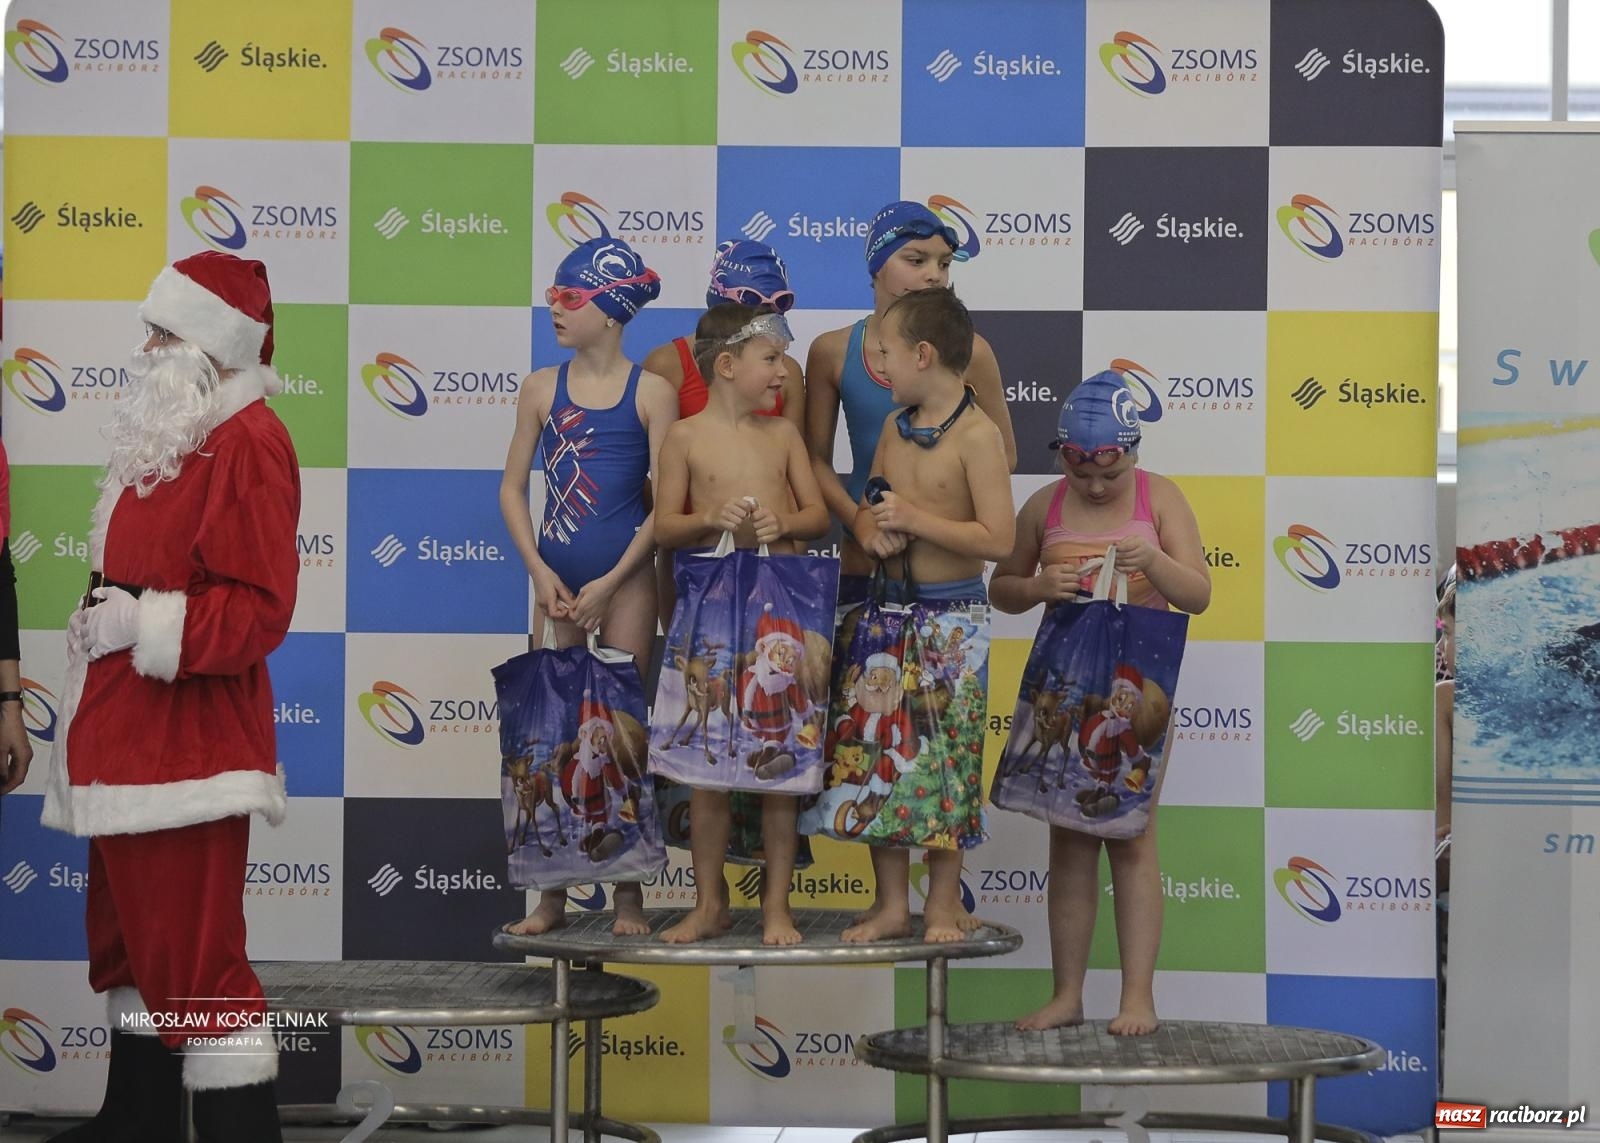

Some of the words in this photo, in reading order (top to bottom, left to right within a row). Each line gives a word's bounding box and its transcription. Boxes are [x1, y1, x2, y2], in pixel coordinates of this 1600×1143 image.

[74, 38, 160, 60] ZSOMS
[240, 42, 328, 73] Śląskie.
[437, 46, 523, 68] ZSOMS
[803, 49, 889, 71] ZSOMS
[1171, 49, 1257, 70] ZSOMS
[74, 63, 161, 73] RACIBÓRZ
[606, 48, 694, 78] Śląskie.
[973, 50, 1061, 81] Śląskie.
[1342, 49, 1430, 79] Śląskie.
[436, 70, 523, 80] RACIBÓRZ
[803, 73, 889, 83] RACIBÓRZ
[1171, 72, 1257, 82] RACIBÓRZ
[57, 203, 143, 233] Śląskie.
[251, 205, 337, 227] ZSOMS
[421, 208, 508, 239] Śląskie.
[618, 210, 704, 232] ZSOMS
[788, 211, 868, 242] Śląskie
[985, 213, 1072, 234] ZSOMS
[1348, 213, 1434, 234] ZSOMS
[251, 230, 337, 240] RACIBÓRZ
[1156, 213, 1243, 243] Śląskie.
[985, 236, 1072, 246] RACIBÓRZ
[1348, 237, 1435, 247] RACIBÓRZ
[433, 371, 519, 393] ZSOMS
[1005, 380, 1058, 402] skie.
[1167, 377, 1254, 398] ZSOMS
[1338, 378, 1426, 409] Śląskie.
[1167, 400, 1254, 411] RACIBÓRZ
[416, 535, 505, 566] Śląskie.
[1345, 543, 1431, 565] ZSOMS
[1345, 567, 1432, 577] RACIBÓRZ
[429, 700, 501, 721] ZSOM
[429, 724, 494, 734] RACIBÓ
[1336, 710, 1425, 741] Śląskie.
[1177, 732, 1252, 742] ACIBÓRZ
[245, 863, 331, 884] ZSOMS
[414, 864, 502, 891] Śląskie.
[980, 870, 1048, 892] ZSOM
[245, 886, 331, 896] RACIBÓRZ
[980, 894, 1044, 904] RACIBÓ
[1346, 877, 1432, 899] ZSOMS
[1346, 902, 1433, 912] RACIBÓRZ
[61, 1027, 108, 1048] ZSO
[427, 1028, 513, 1050] ZSOMS
[427, 1052, 513, 1062] RACIBÓRZ
